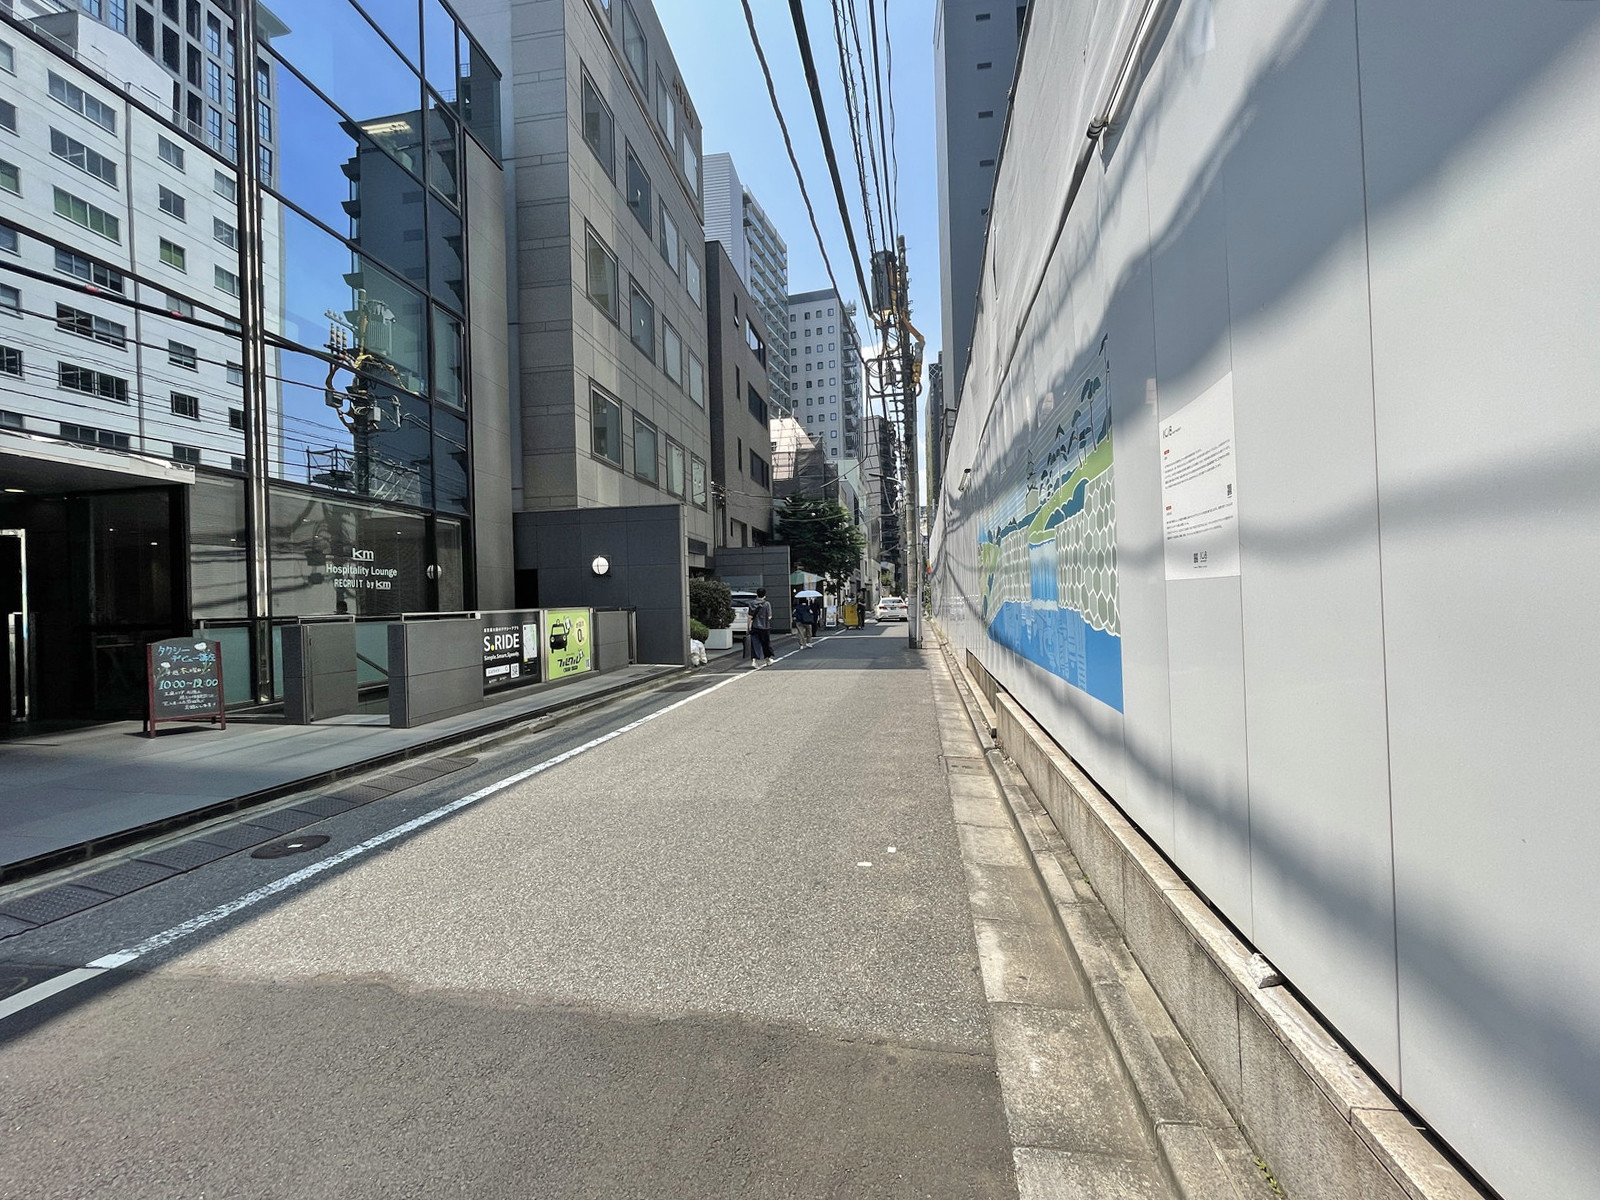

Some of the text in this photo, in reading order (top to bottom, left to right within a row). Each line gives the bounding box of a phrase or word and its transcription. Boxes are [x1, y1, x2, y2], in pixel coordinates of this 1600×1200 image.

[352, 548, 374, 561] km
[326, 564, 397, 578] Hospitality Lounge
[334, 578, 392, 590] RECRUIT by km
[483, 633, 520, 652] S.RIDE
[158, 645, 191, 657] タクシー
